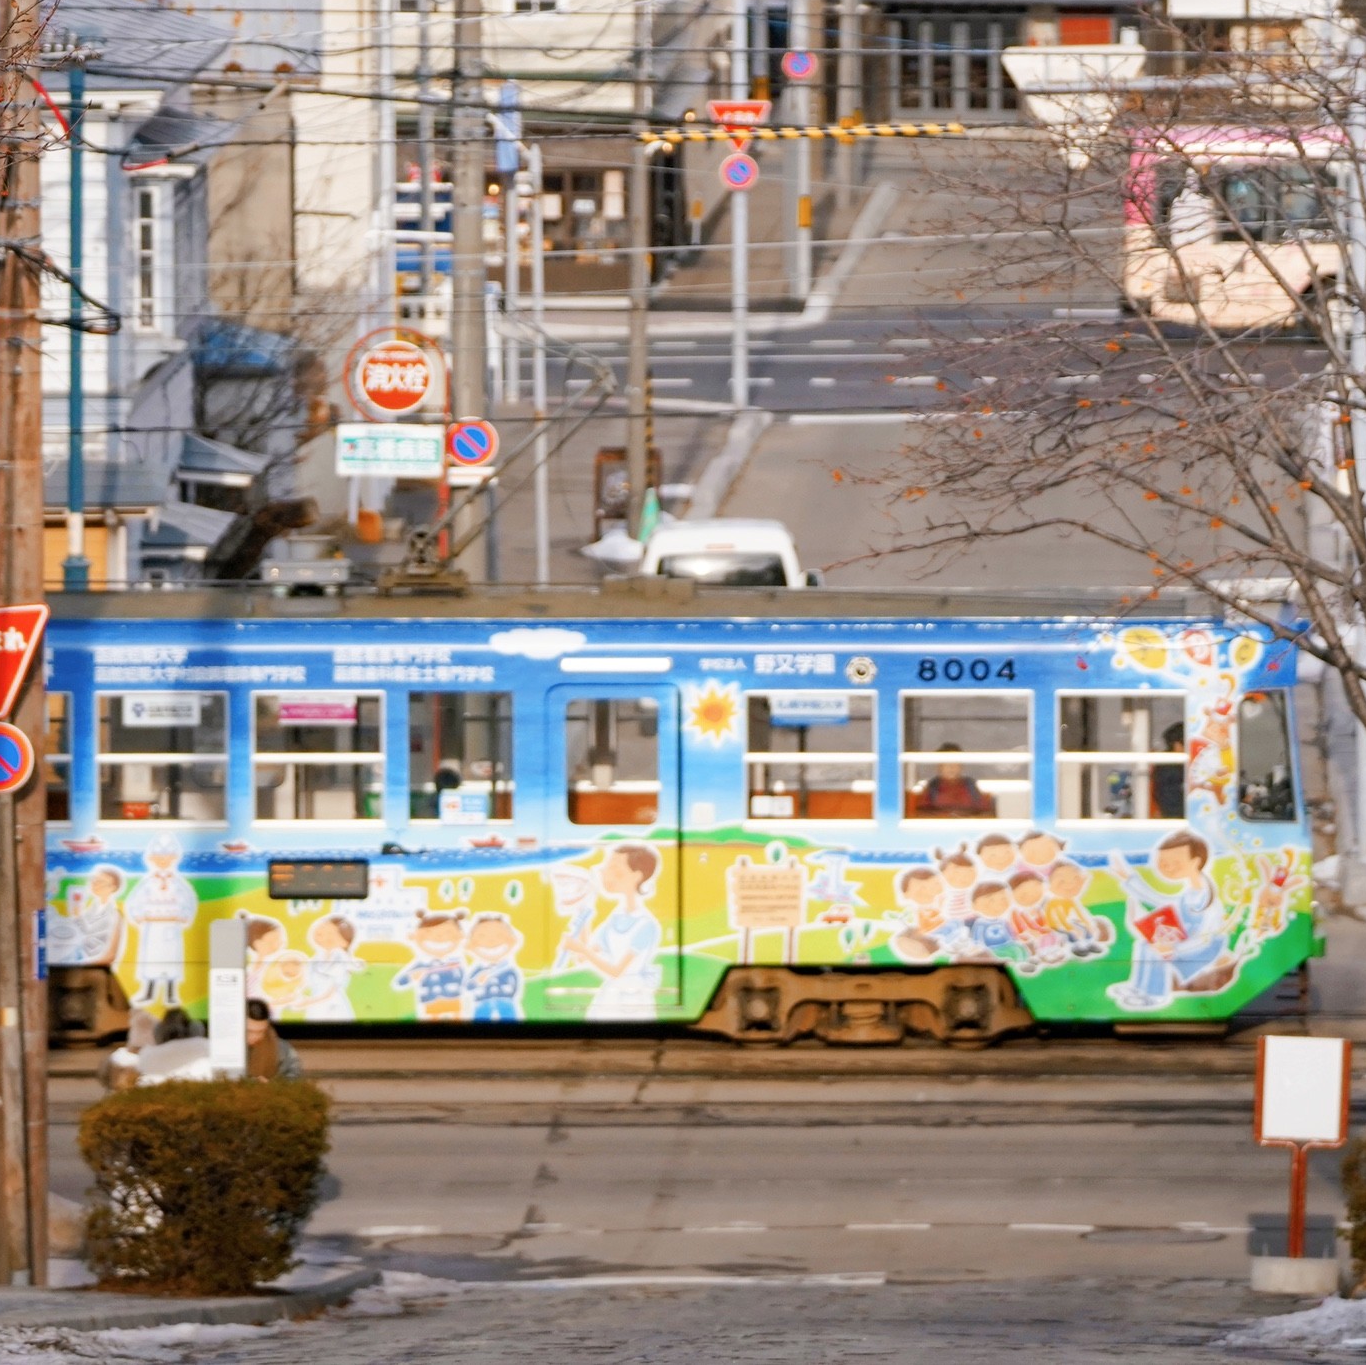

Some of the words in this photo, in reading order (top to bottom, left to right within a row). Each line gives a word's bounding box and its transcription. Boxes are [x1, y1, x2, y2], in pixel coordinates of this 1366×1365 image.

[365, 363, 427, 392] 消火栓
[754, 653, 836, 675] 野又学園
[918, 657, 1016, 682] 8004
